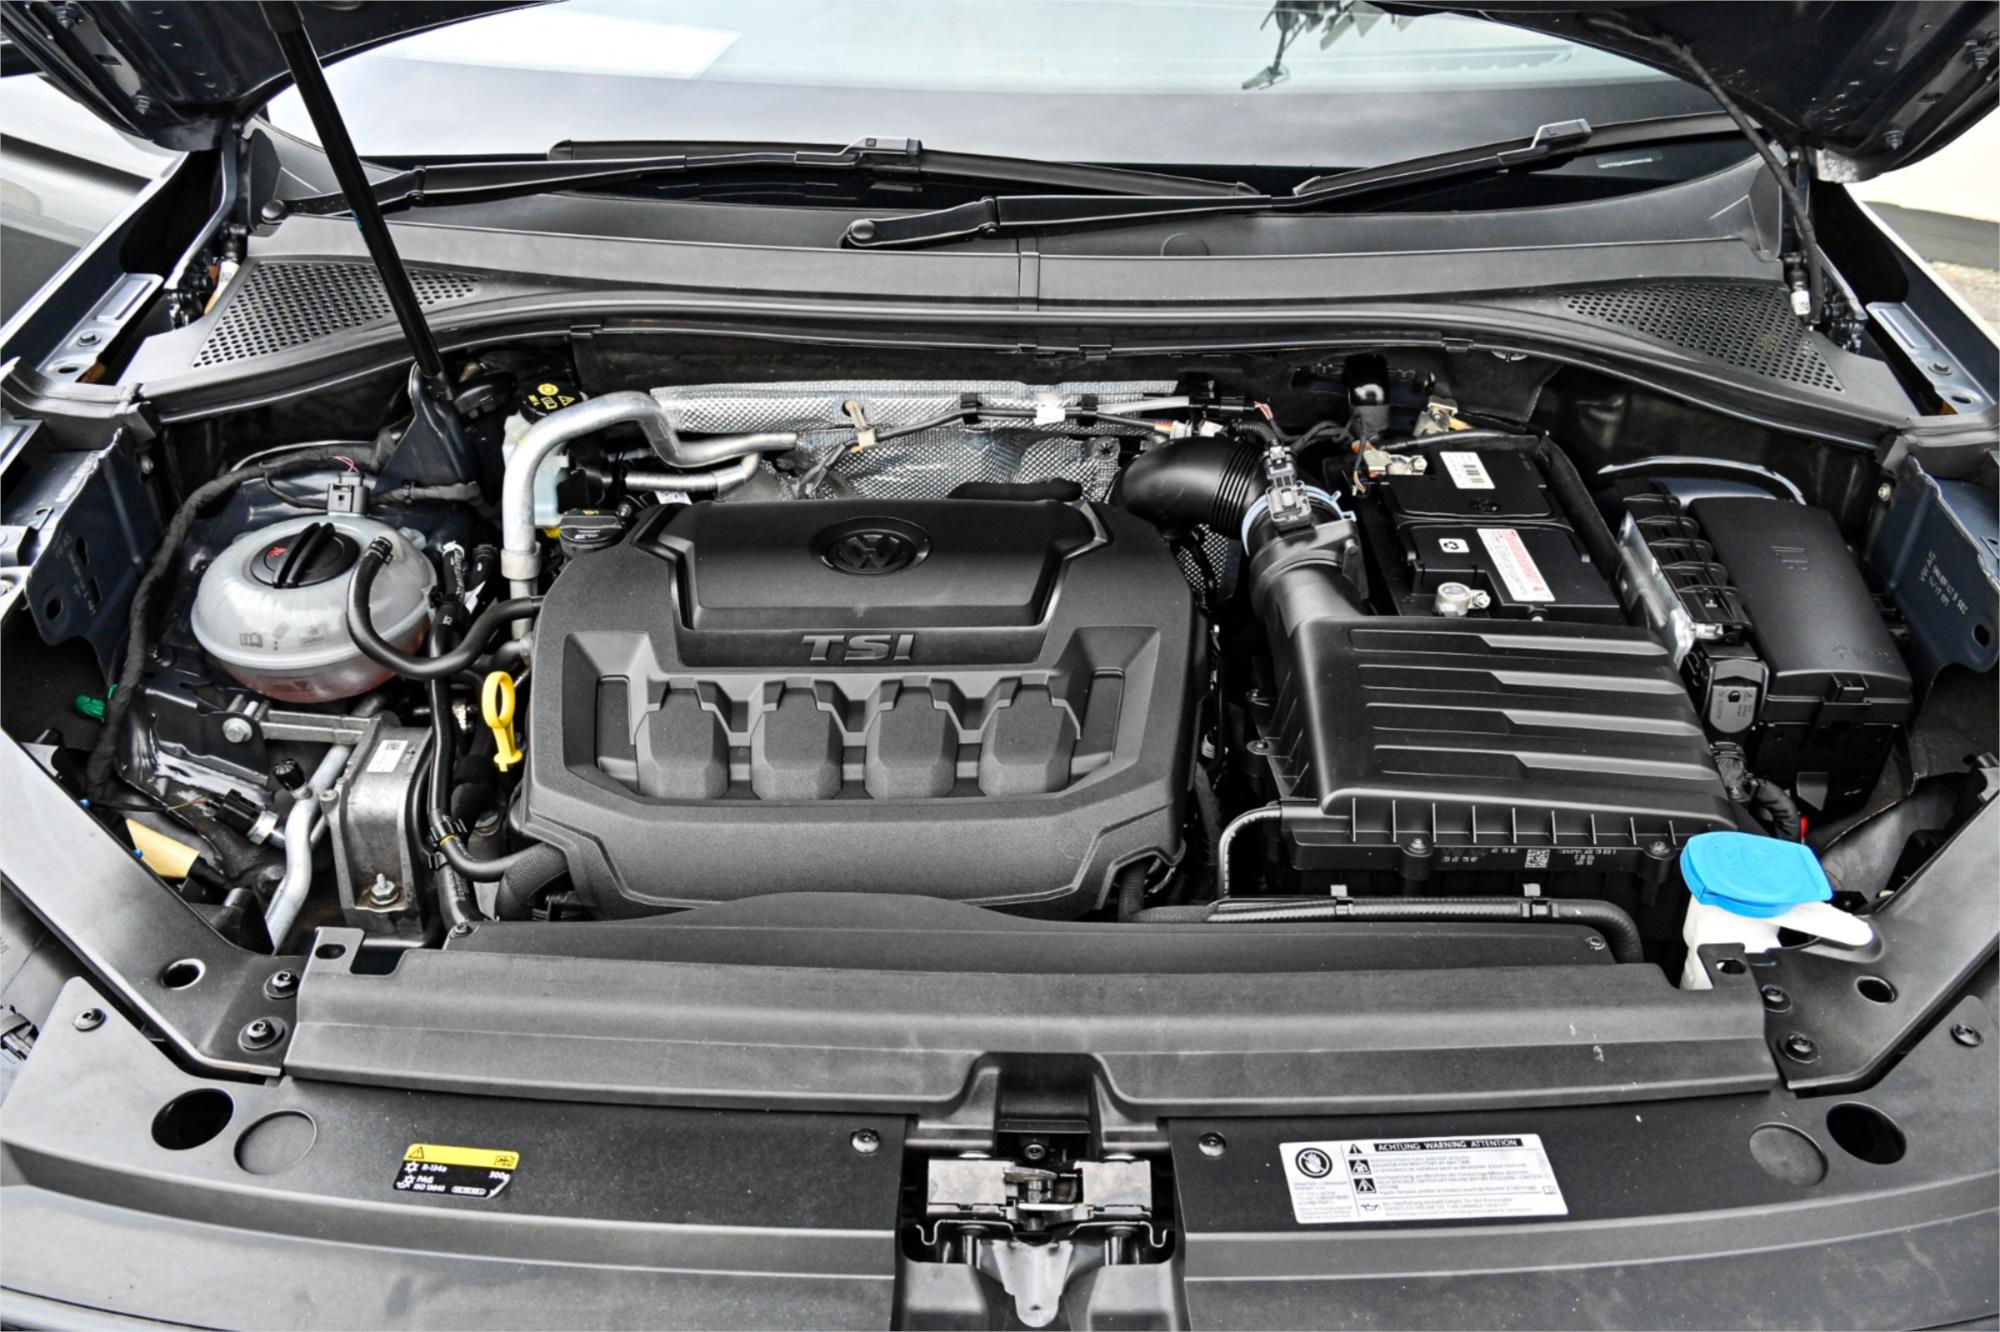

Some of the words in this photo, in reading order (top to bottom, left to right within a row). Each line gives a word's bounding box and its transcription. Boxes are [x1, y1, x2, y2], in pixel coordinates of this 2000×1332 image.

[802, 634, 914, 661] TSI
[1378, 1143, 1421, 1151] ACHTUNG
[1424, 1141, 1467, 1149] WARNING
[1471, 1138, 1517, 1147] ATTENTION
